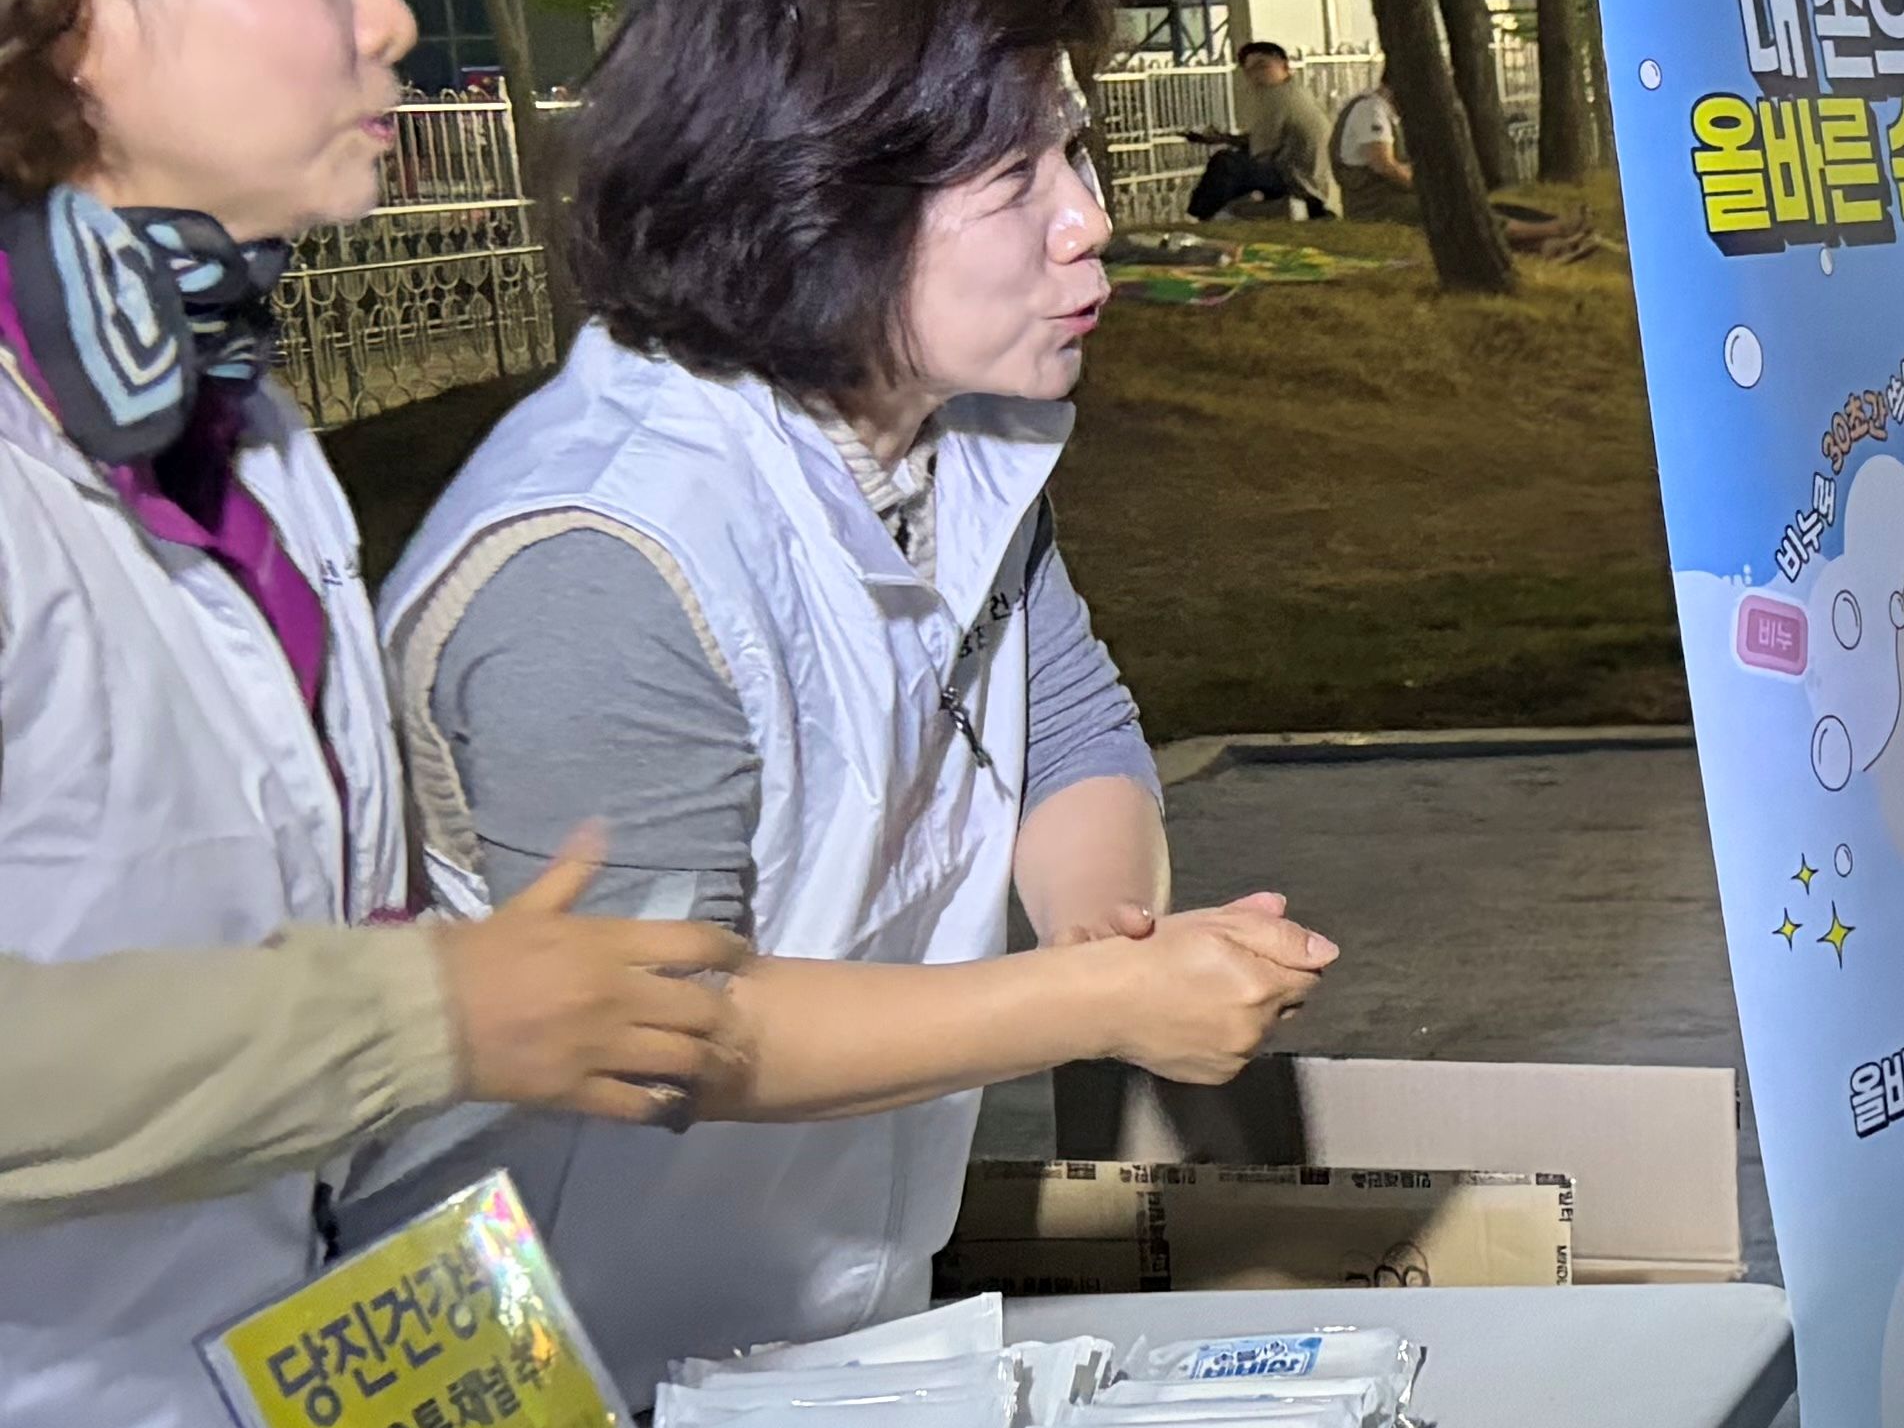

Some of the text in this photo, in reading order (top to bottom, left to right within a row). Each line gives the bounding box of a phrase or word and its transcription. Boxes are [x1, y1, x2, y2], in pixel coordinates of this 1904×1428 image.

[1691, 93, 1890, 237] 올바른
[1774, 472, 1836, 584] 비누로
[1821, 389, 1888, 476] 30초간
[1757, 615, 1793, 650] 비누
[446, 1356, 522, 1427] 채널
